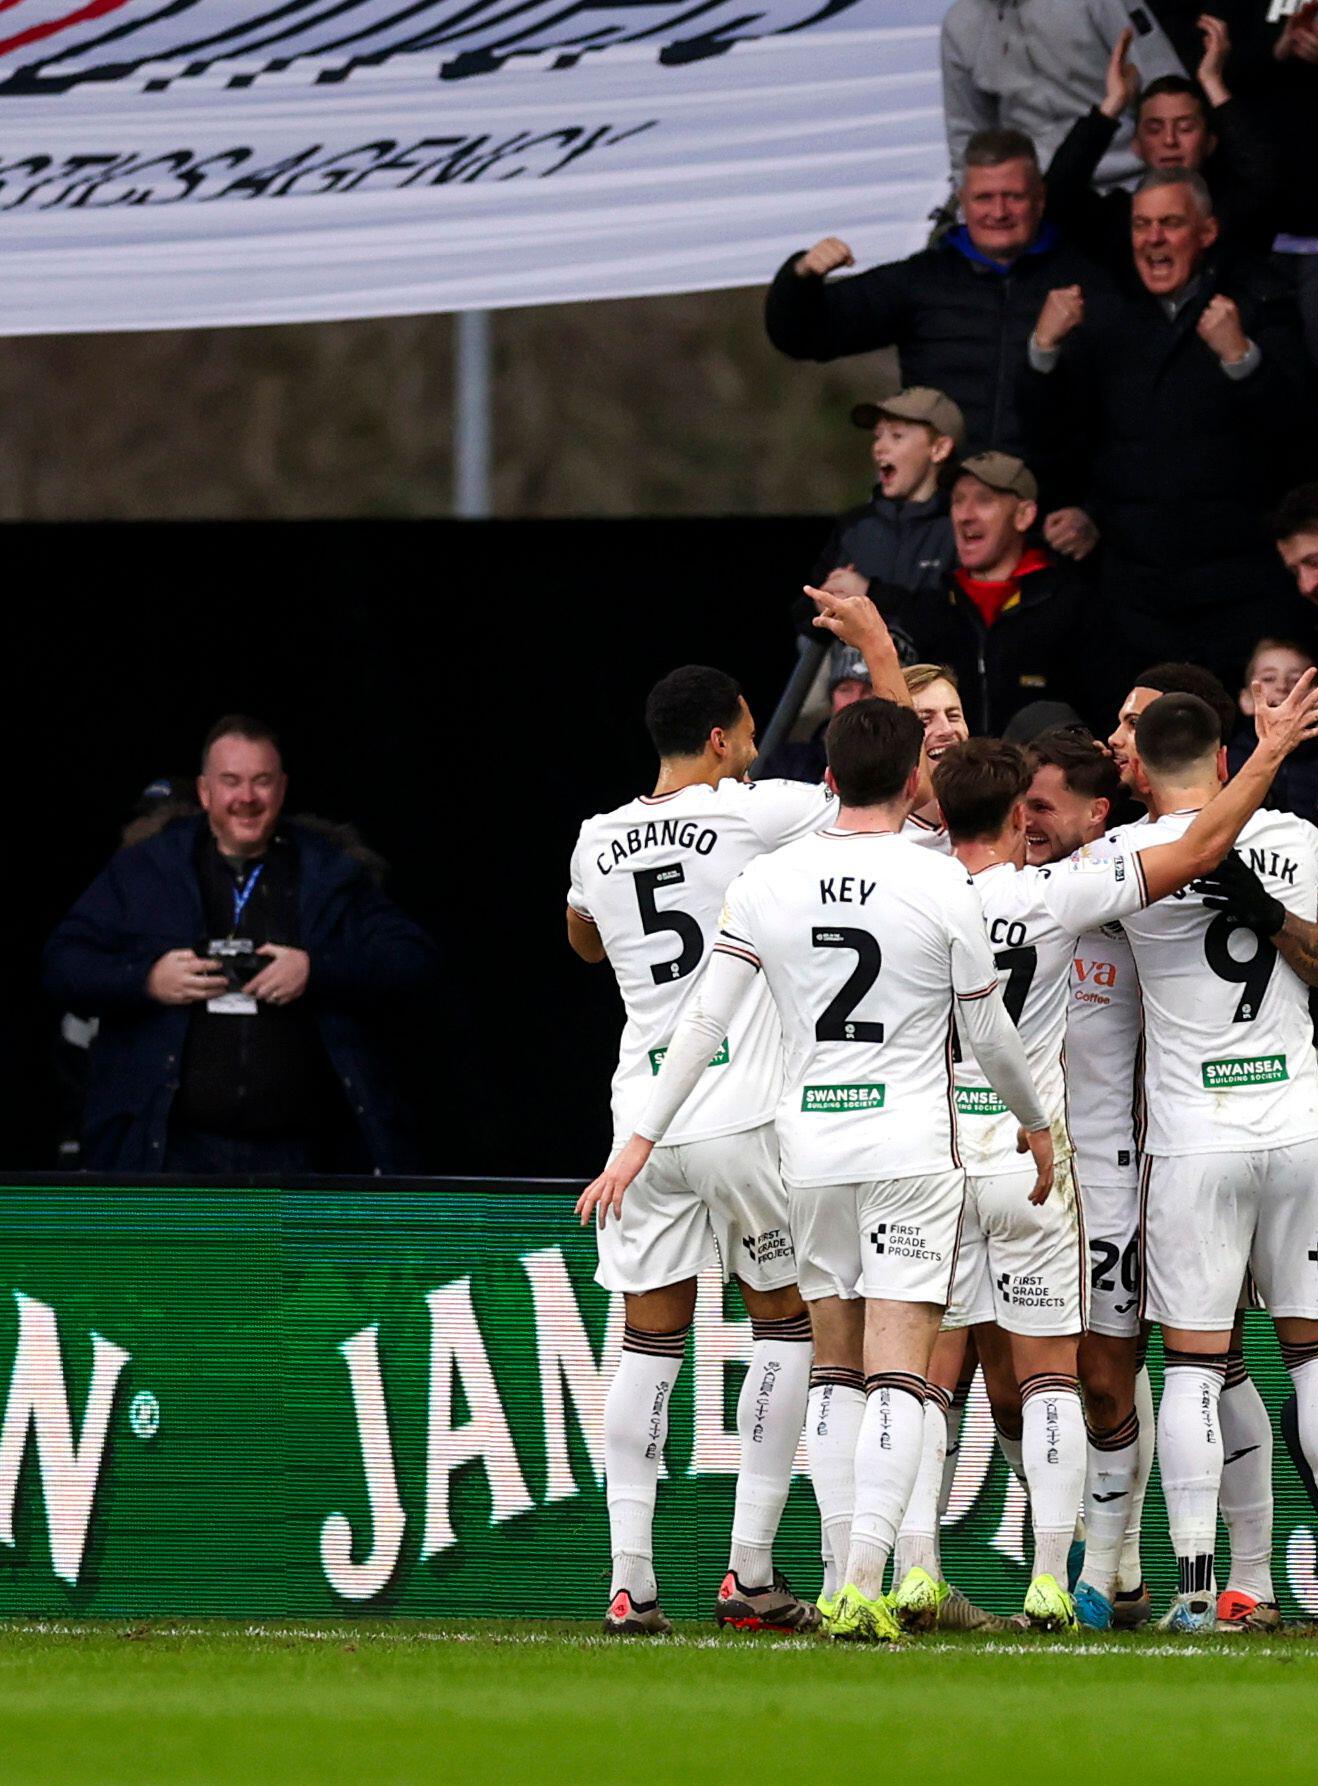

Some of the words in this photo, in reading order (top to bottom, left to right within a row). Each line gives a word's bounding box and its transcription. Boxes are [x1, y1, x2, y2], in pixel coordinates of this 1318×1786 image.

[200, 118, 659, 202] AGENCY
[597, 819, 718, 876] CABANGO
[1237, 847, 1298, 885] NIK
[819, 876, 877, 906] KEY
[633, 862, 704, 986] 5
[984, 916, 1027, 948] CO
[1204, 908, 1279, 1022] 9
[811, 926, 884, 1044] 2
[1206, 1059, 1283, 1078] SWANSEA
[1210, 1075, 1248, 1085] BUILDING
[1250, 1071, 1282, 1081] SOCIETY
[806, 1088, 881, 1102] SWANSEA
[890, 1224, 921, 1236] FIRST
[758, 1238, 786, 1254] GRADE
[889, 1235, 926, 1248] GRADE
[888, 1246, 942, 1262] PROJECTS
[1013, 1276, 1044, 1286] FIRST
[1012, 1286, 1049, 1297] GRADE
[1012, 1296, 1066, 1307] PROJECTS
